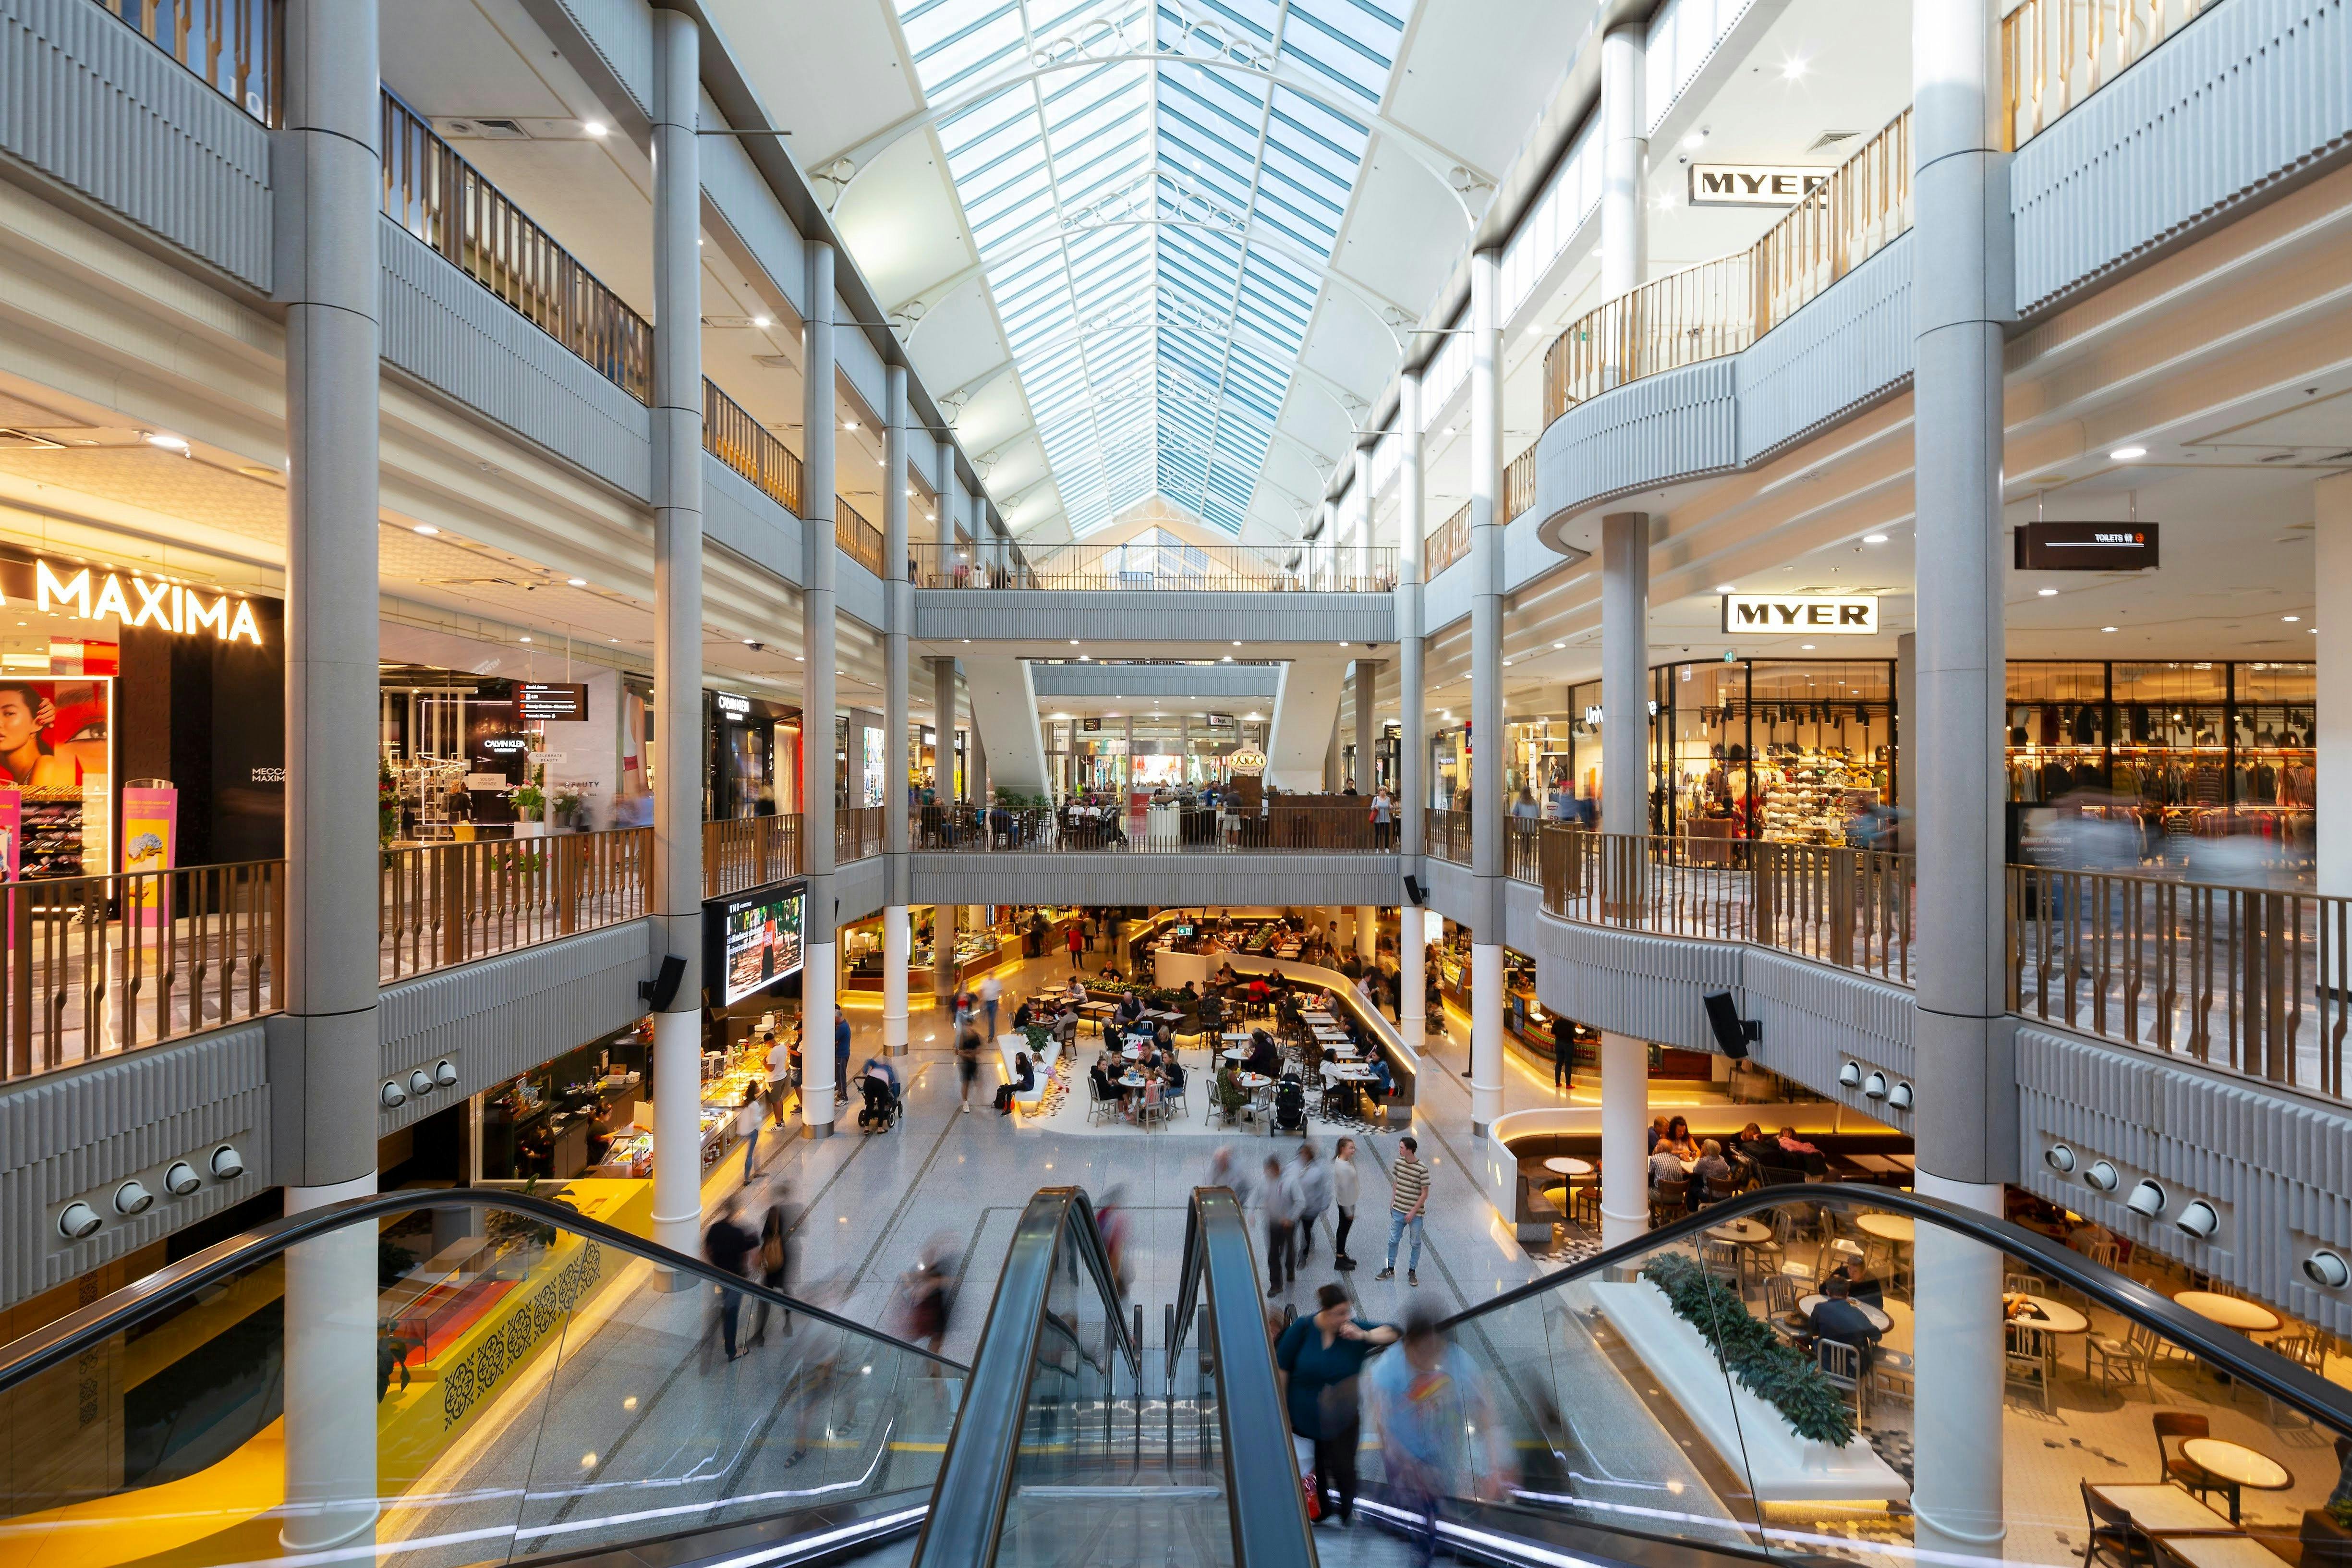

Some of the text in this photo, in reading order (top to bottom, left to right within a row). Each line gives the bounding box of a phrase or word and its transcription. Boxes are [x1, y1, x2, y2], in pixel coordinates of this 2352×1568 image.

[2095, 534, 2123, 542] TOILETS
[36, 559, 262, 645] MAXIMA
[1738, 604, 1868, 625] MYER
